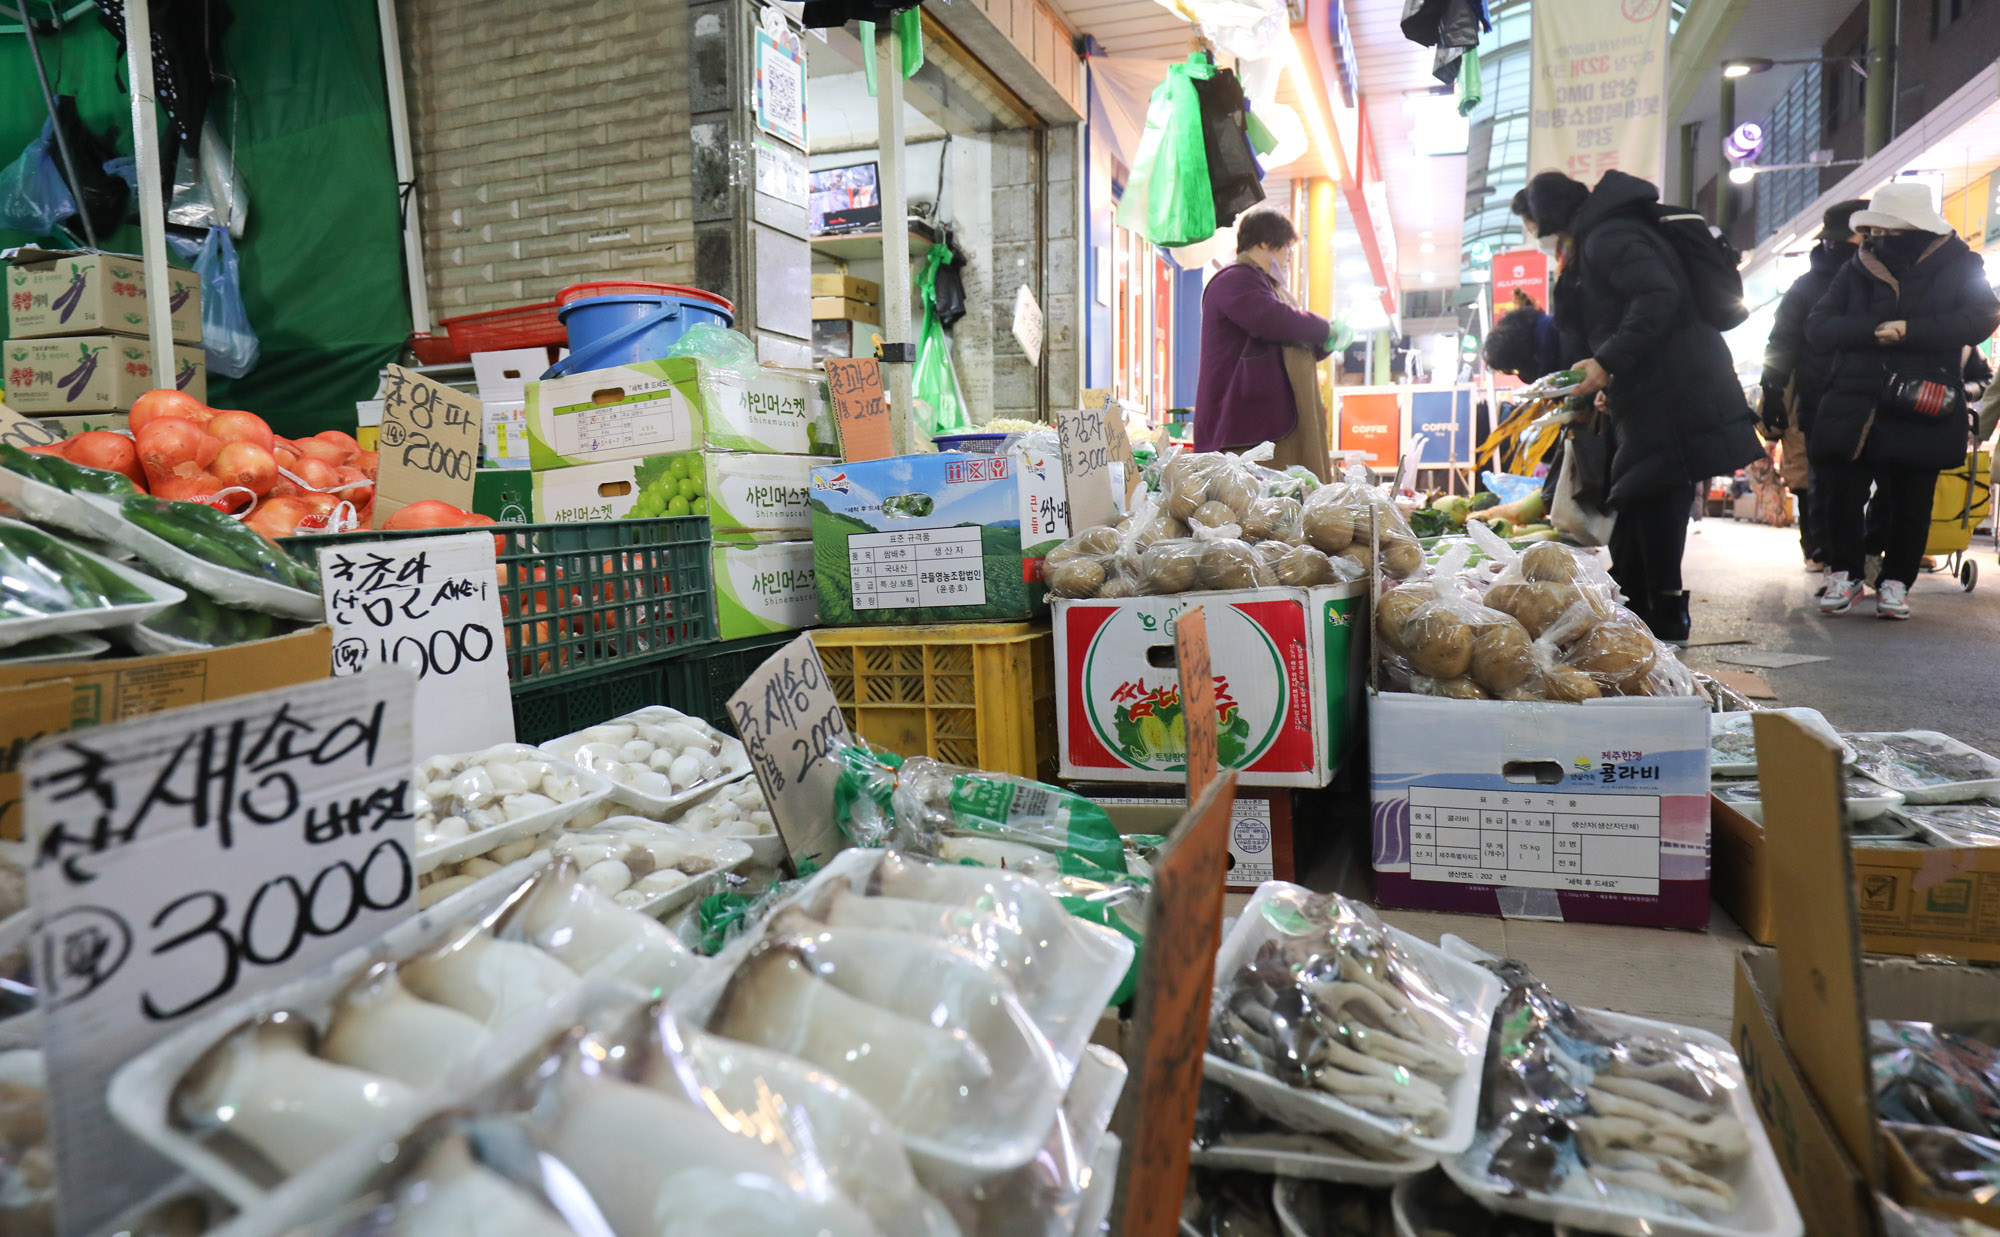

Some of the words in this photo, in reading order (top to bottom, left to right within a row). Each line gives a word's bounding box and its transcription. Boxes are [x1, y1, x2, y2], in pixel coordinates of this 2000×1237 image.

[410, 383, 477, 436] 양파
[739, 391, 806, 420] 샤인머스켓
[748, 416, 800, 429] Shinemuscat
[1072, 411, 1104, 443] 감자
[1421, 423, 1459, 432] COFFEE
[1352, 425, 1388, 434] COFFEE
[402, 431, 472, 482] 2000
[745, 487, 812, 509] 샤인머스켓
[555, 503, 613, 523] 샤인머스켓
[755, 508, 807, 519] Shinemuscat
[1040, 496, 1069, 534] 쌈배
[889, 534, 904, 543] 표준
[907, 532, 931, 543] 규격품
[884, 549, 907, 560] 쌈배추
[884, 563, 908, 574] 국내산
[752, 570, 816, 595] 샤인머스
[920, 569, 982, 584] 큰들영농조합법인
[905, 595, 915, 604] kg
[380, 622, 494, 681] 1000
[765, 638, 832, 736] 새송이
[120, 701, 386, 849] 새송이
[304, 779, 416, 844] 버섯
[1600, 763, 1660, 784] 콜라비
[1447, 814, 1470, 823] 콜라비
[1571, 820, 1640, 830] 생산자(생산자단체)
[1484, 850, 1505, 858] (개수)
[1530, 843, 1540, 852] kg
[1439, 852, 1478, 861] 제주특별자치도
[1500, 873, 1507, 881] 년
[1584, 878, 1592, 887] 후
[141, 838, 414, 1022] 3000
